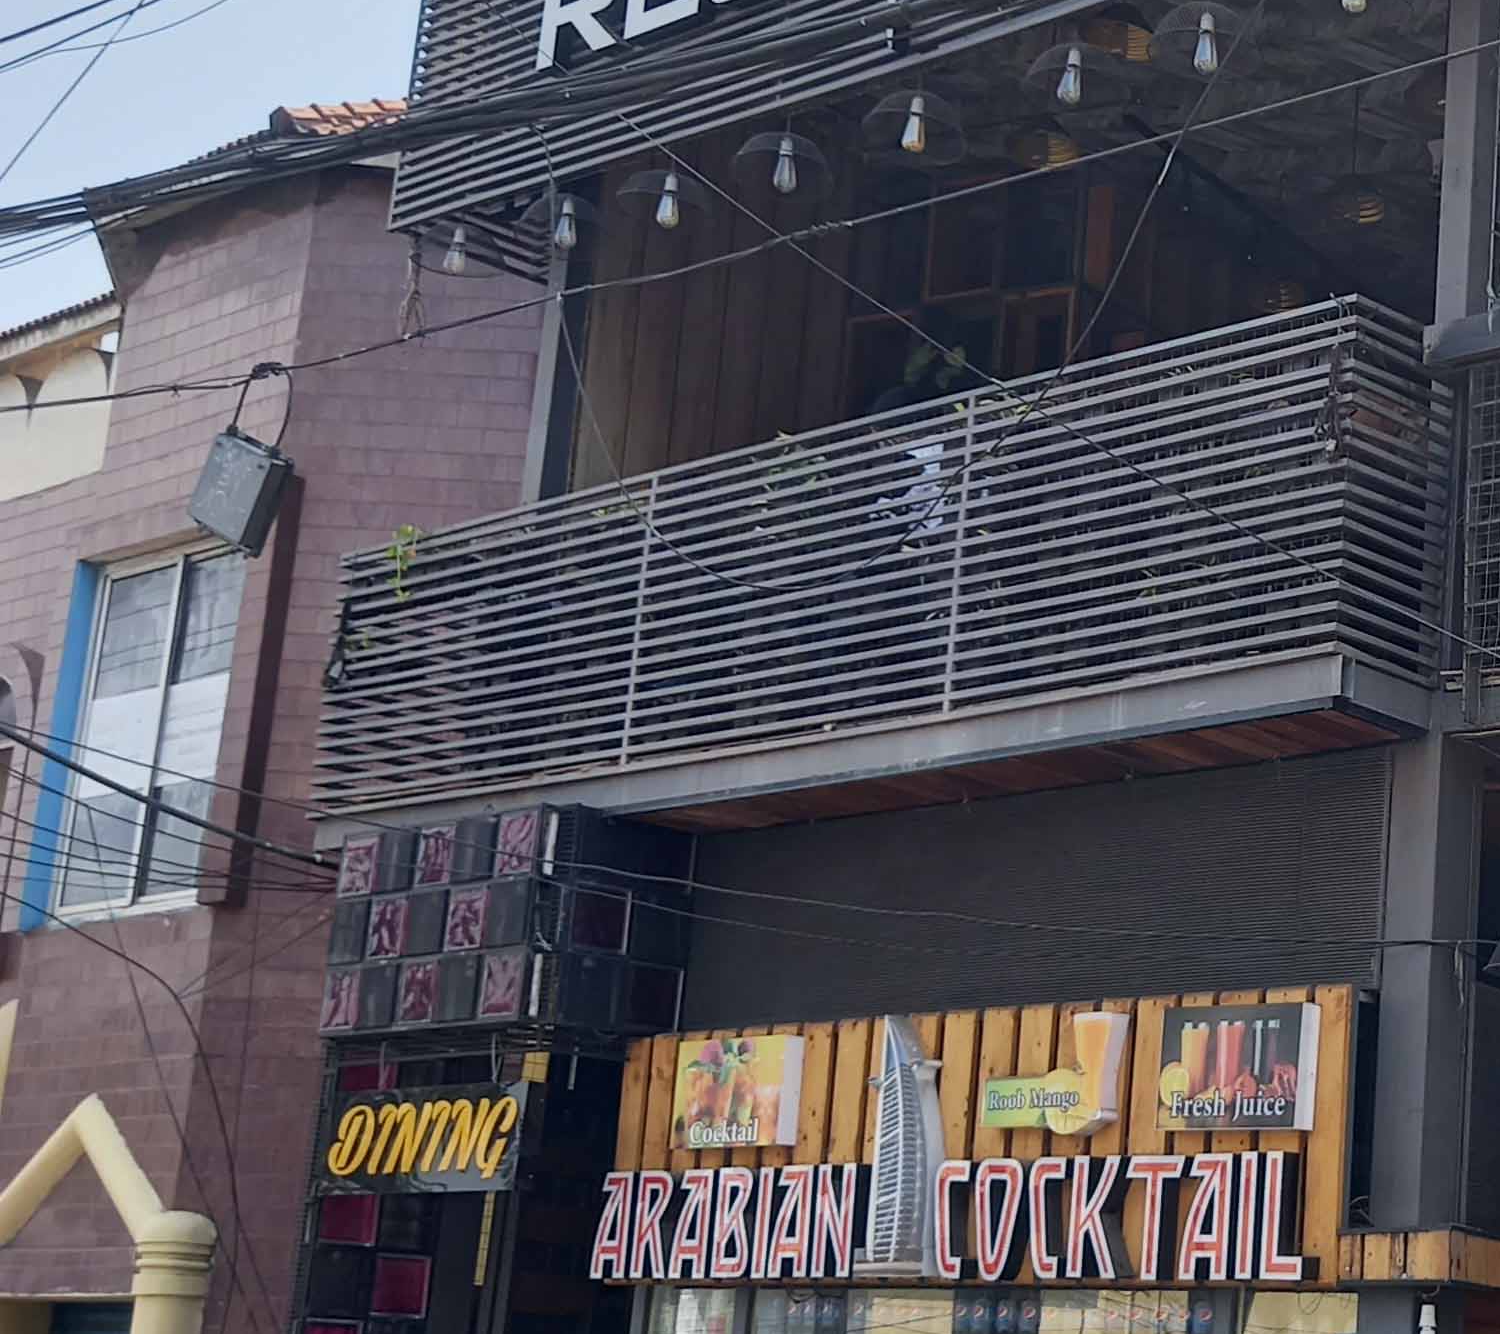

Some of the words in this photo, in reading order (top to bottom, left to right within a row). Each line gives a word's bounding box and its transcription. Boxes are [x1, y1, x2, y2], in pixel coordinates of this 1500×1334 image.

[1029, 1087, 1080, 1115] Mango
[1170, 1090, 1226, 1117] Fresh
[1230, 1091, 1287, 1120] Juice
[328, 1096, 518, 1179] DINING
[688, 1118, 759, 1146] Cocktail
[589, 1162, 859, 1280] ARABIAN
[934, 1149, 1303, 1281] COCKTAIL
